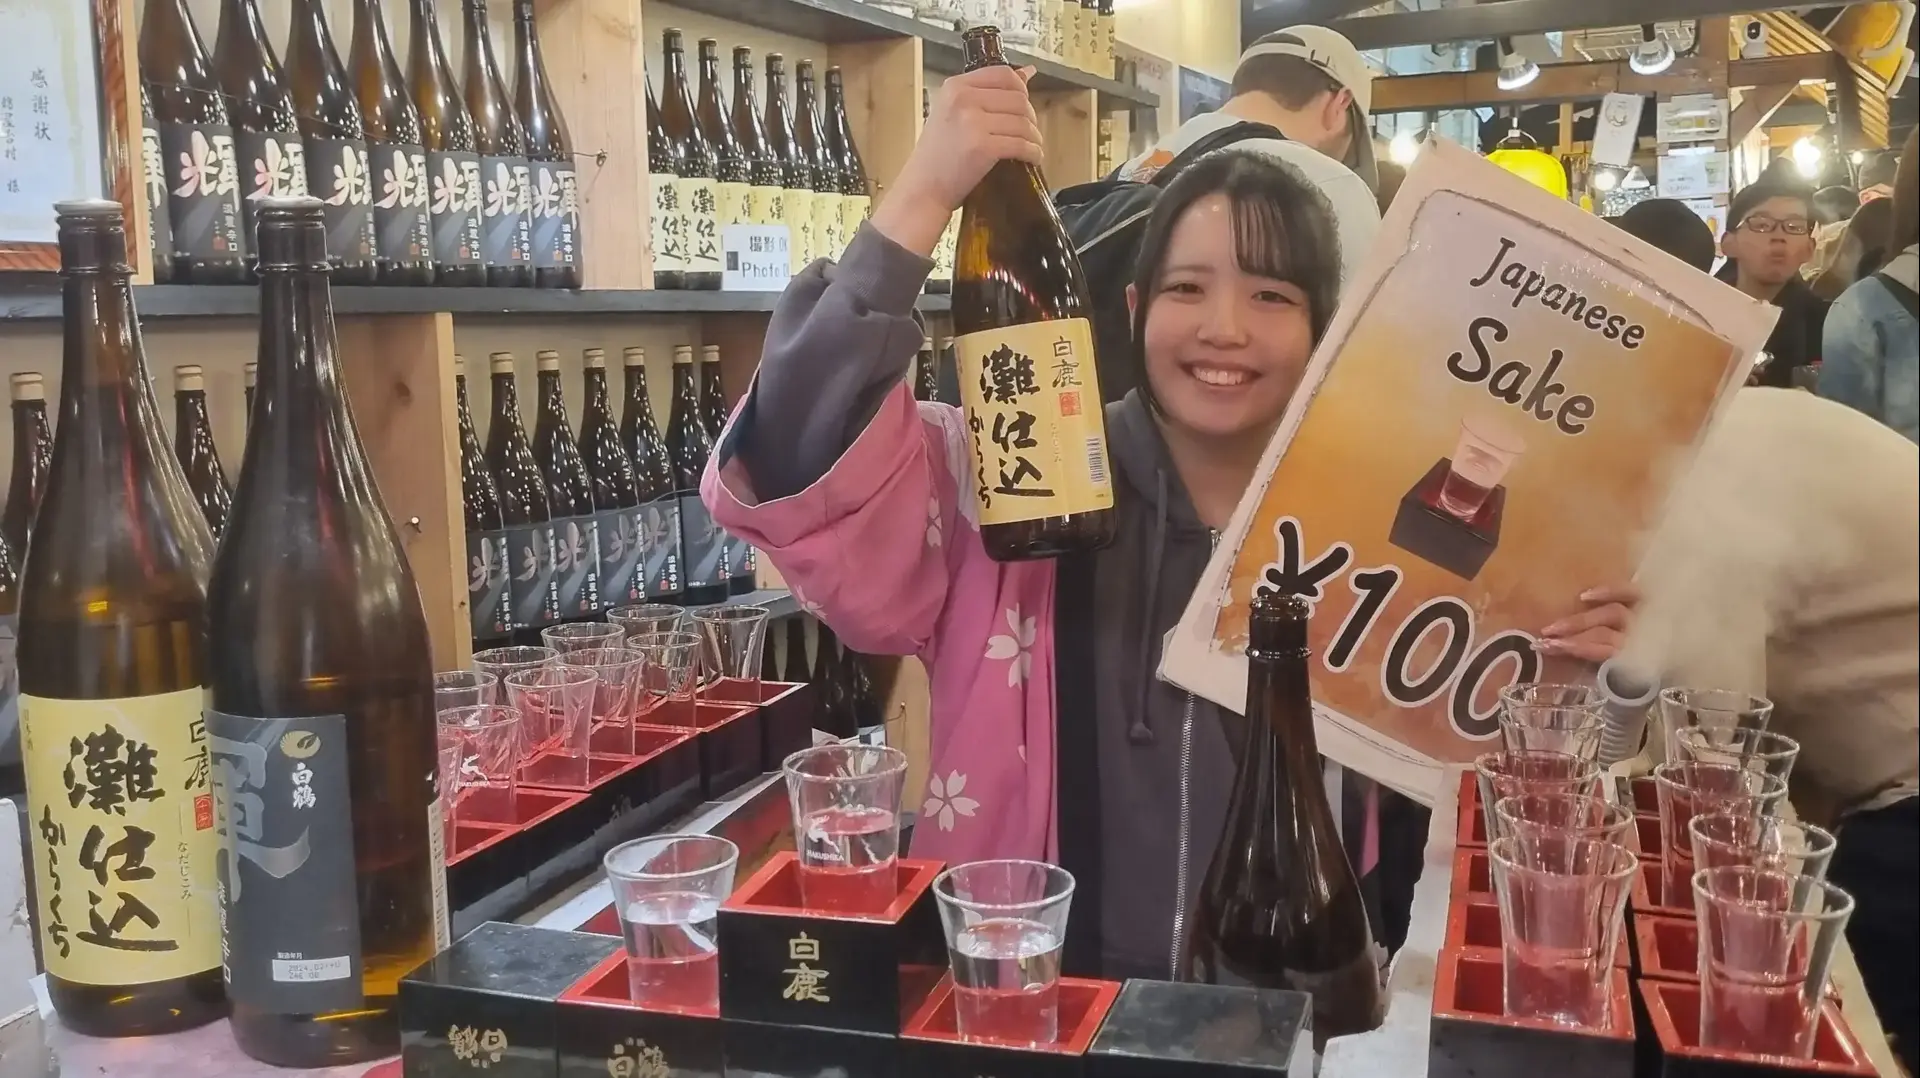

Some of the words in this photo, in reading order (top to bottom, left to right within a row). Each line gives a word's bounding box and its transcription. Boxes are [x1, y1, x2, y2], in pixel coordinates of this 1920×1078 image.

[30, 67, 51, 142] 感謝状
[172, 130, 240, 213] 輝
[373, 149, 430, 221] 輝
[430, 157, 484, 226] 輝
[485, 162, 533, 230] 輝
[532, 167, 580, 231] 輝
[690, 186, 719, 262] 灘仕込
[749, 235, 775, 252] 撮影
[742, 261, 780, 278] Photo
[1469, 237, 1648, 350] Japanese
[1051, 335, 1082, 388] 白鹿
[1446, 316, 1597, 437] Sake
[968, 406, 991, 509] からくち
[980, 343, 1055, 497] 灘仕込
[1256, 518, 1541, 741] ¥100
[290, 762, 316, 809] 白鶴
[63, 723, 180, 952] 灘仕込
[38, 804, 70, 959] からくち
[782, 931, 831, 1003] 白鹿
